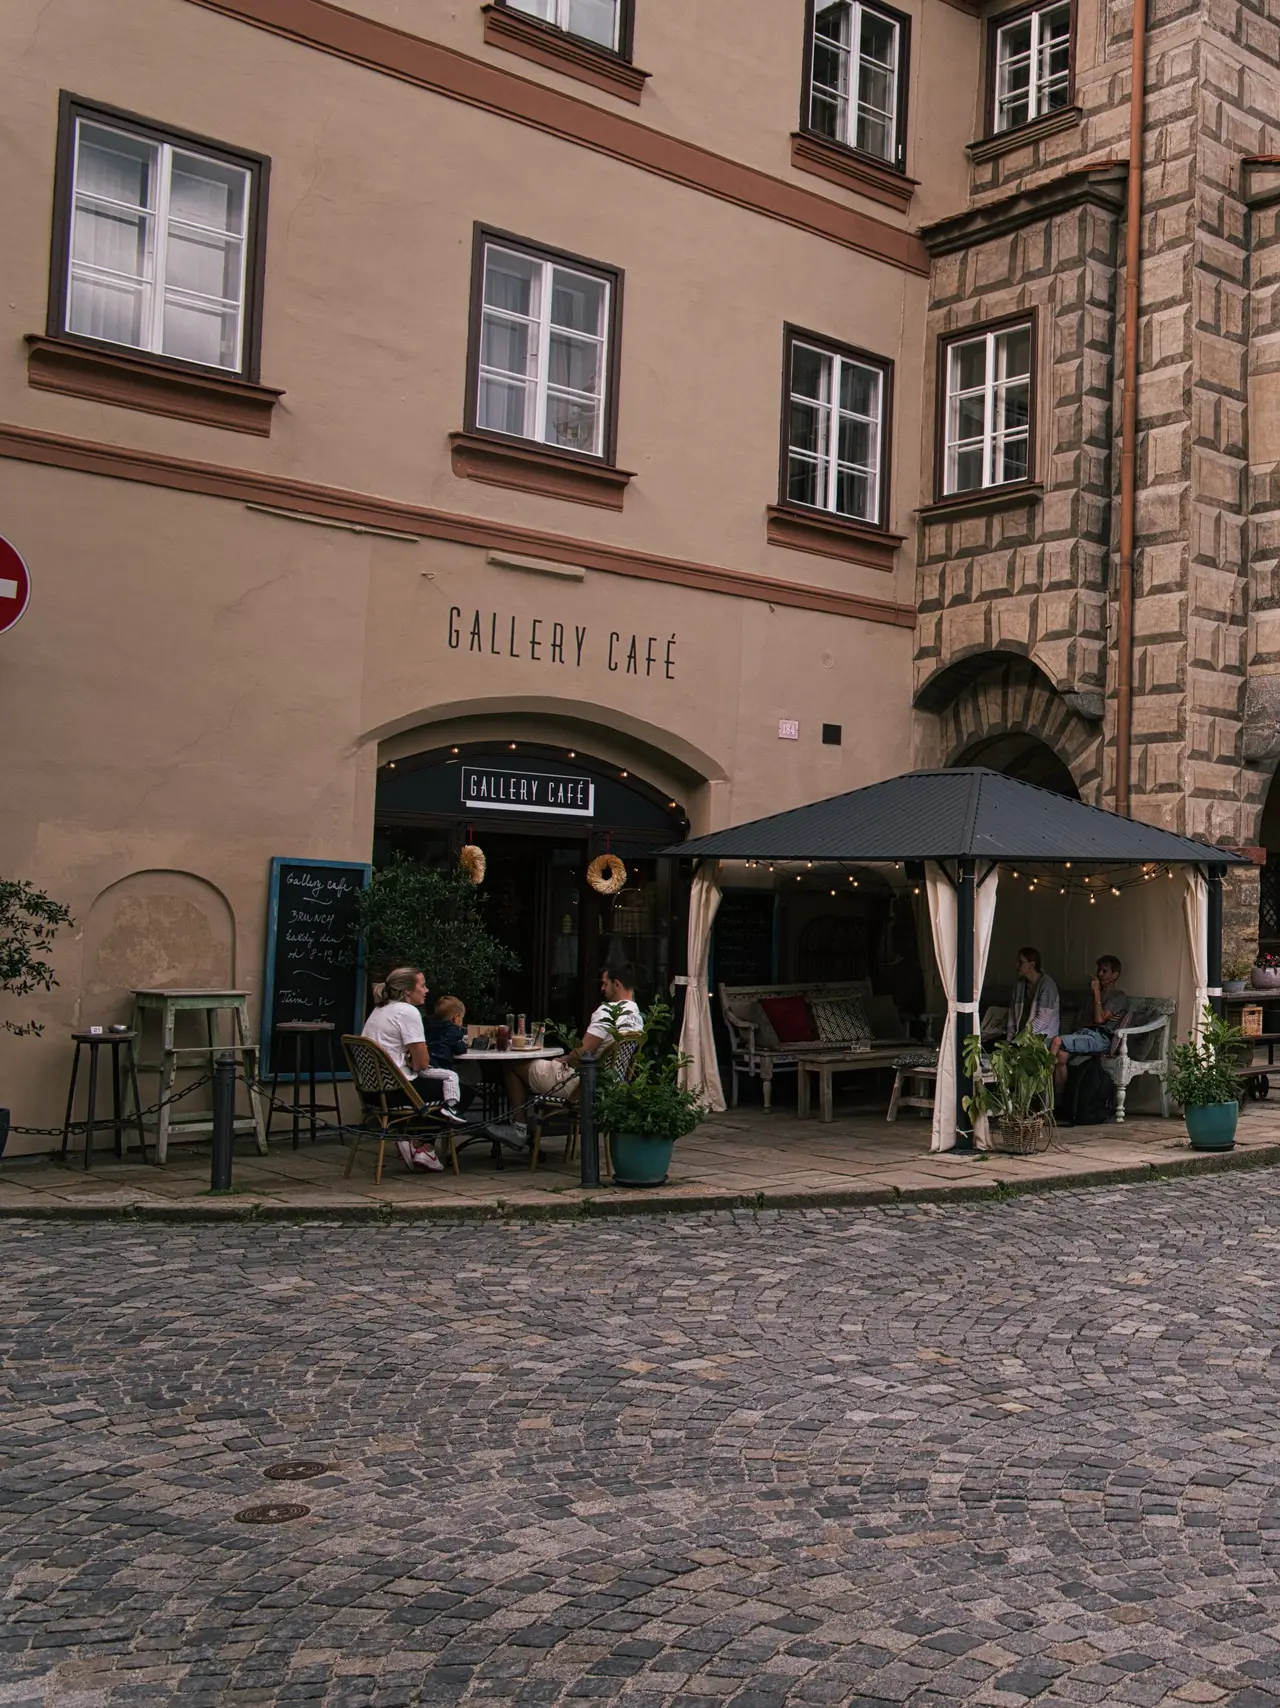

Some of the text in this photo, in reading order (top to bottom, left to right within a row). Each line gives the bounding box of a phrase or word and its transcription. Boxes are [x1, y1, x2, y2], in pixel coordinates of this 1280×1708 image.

[448, 606, 677, 680] GALLERY CAFÉ
[782, 723, 796, 735] 184
[470, 774, 584, 805] GALLERY CAFÉ
